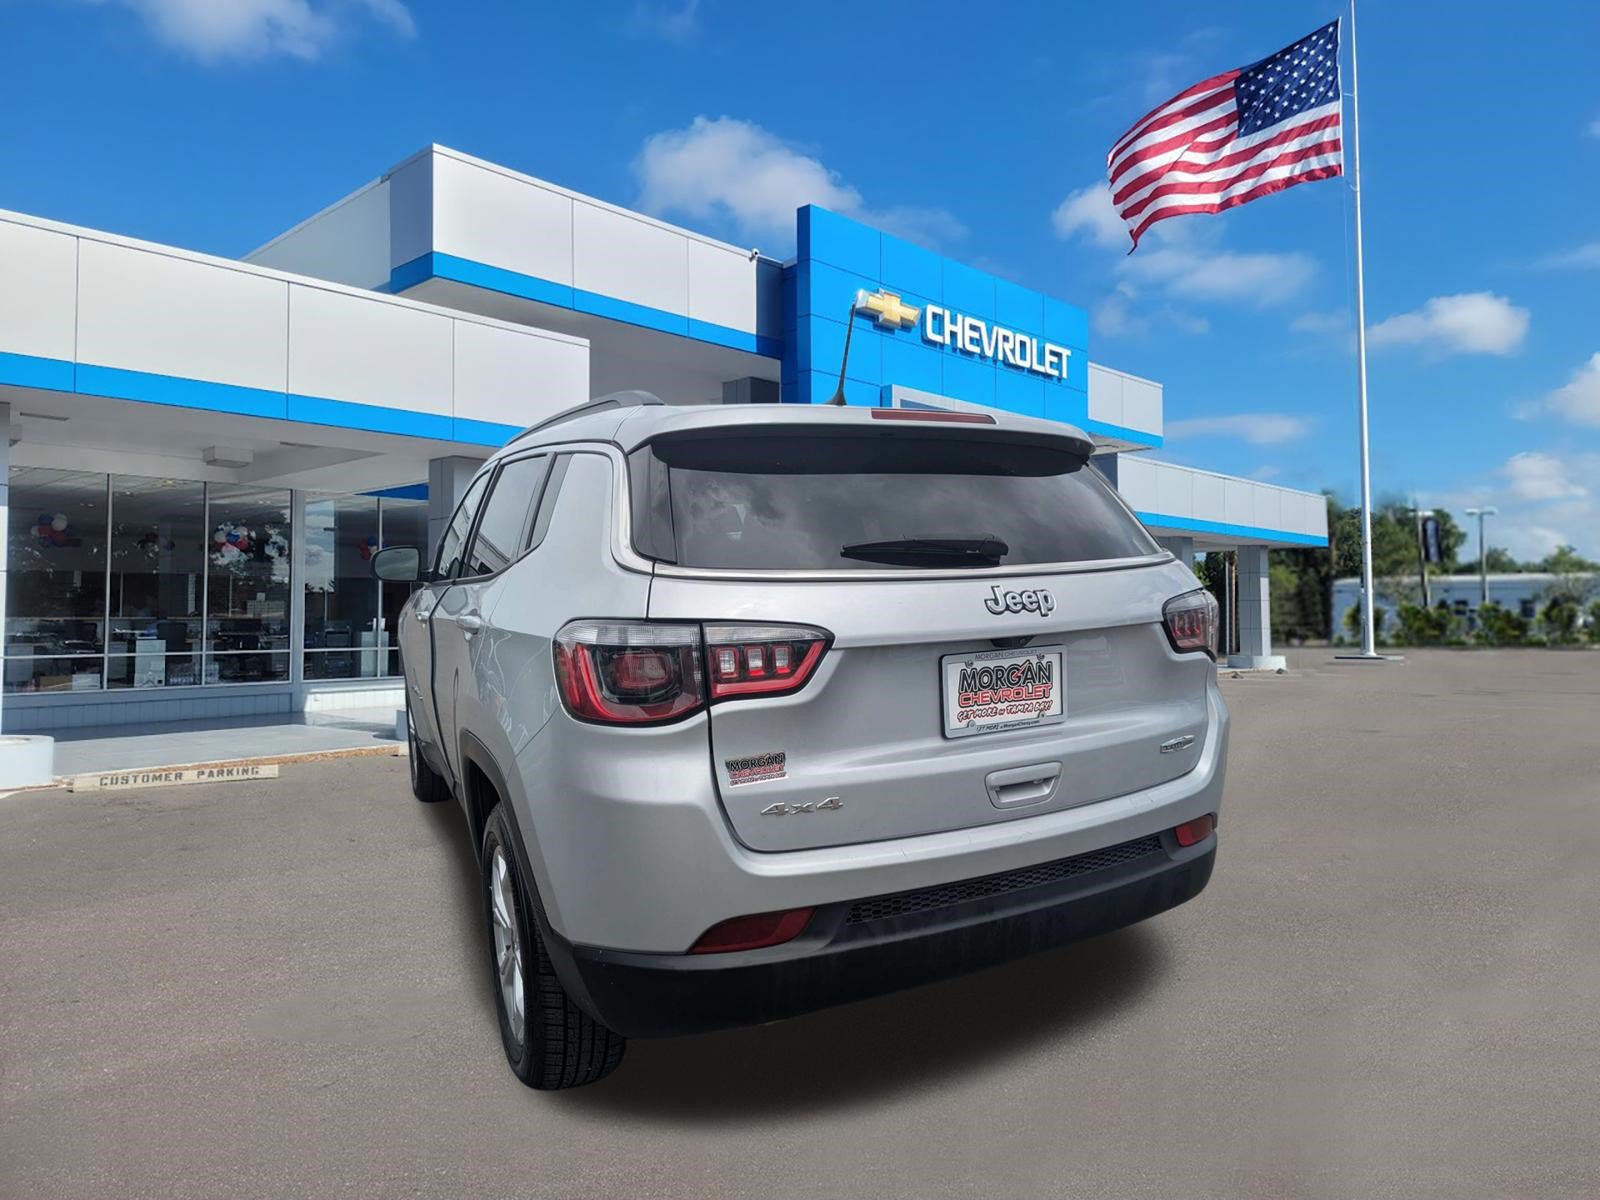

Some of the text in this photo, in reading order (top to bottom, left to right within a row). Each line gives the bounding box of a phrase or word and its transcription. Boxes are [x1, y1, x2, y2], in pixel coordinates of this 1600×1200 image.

[924, 304, 1072, 379] CHEVROLET
[984, 585, 1056, 617] Jeep
[959, 660, 1053, 693] MORGAN
[958, 683, 1053, 708] CHEVROLET
[973, 706, 998, 719] MORE
[1005, 702, 1033, 715] TAMPA
[727, 752, 786, 771] MORGAN
[99, 766, 260, 787] CUSTOMER PARKING
